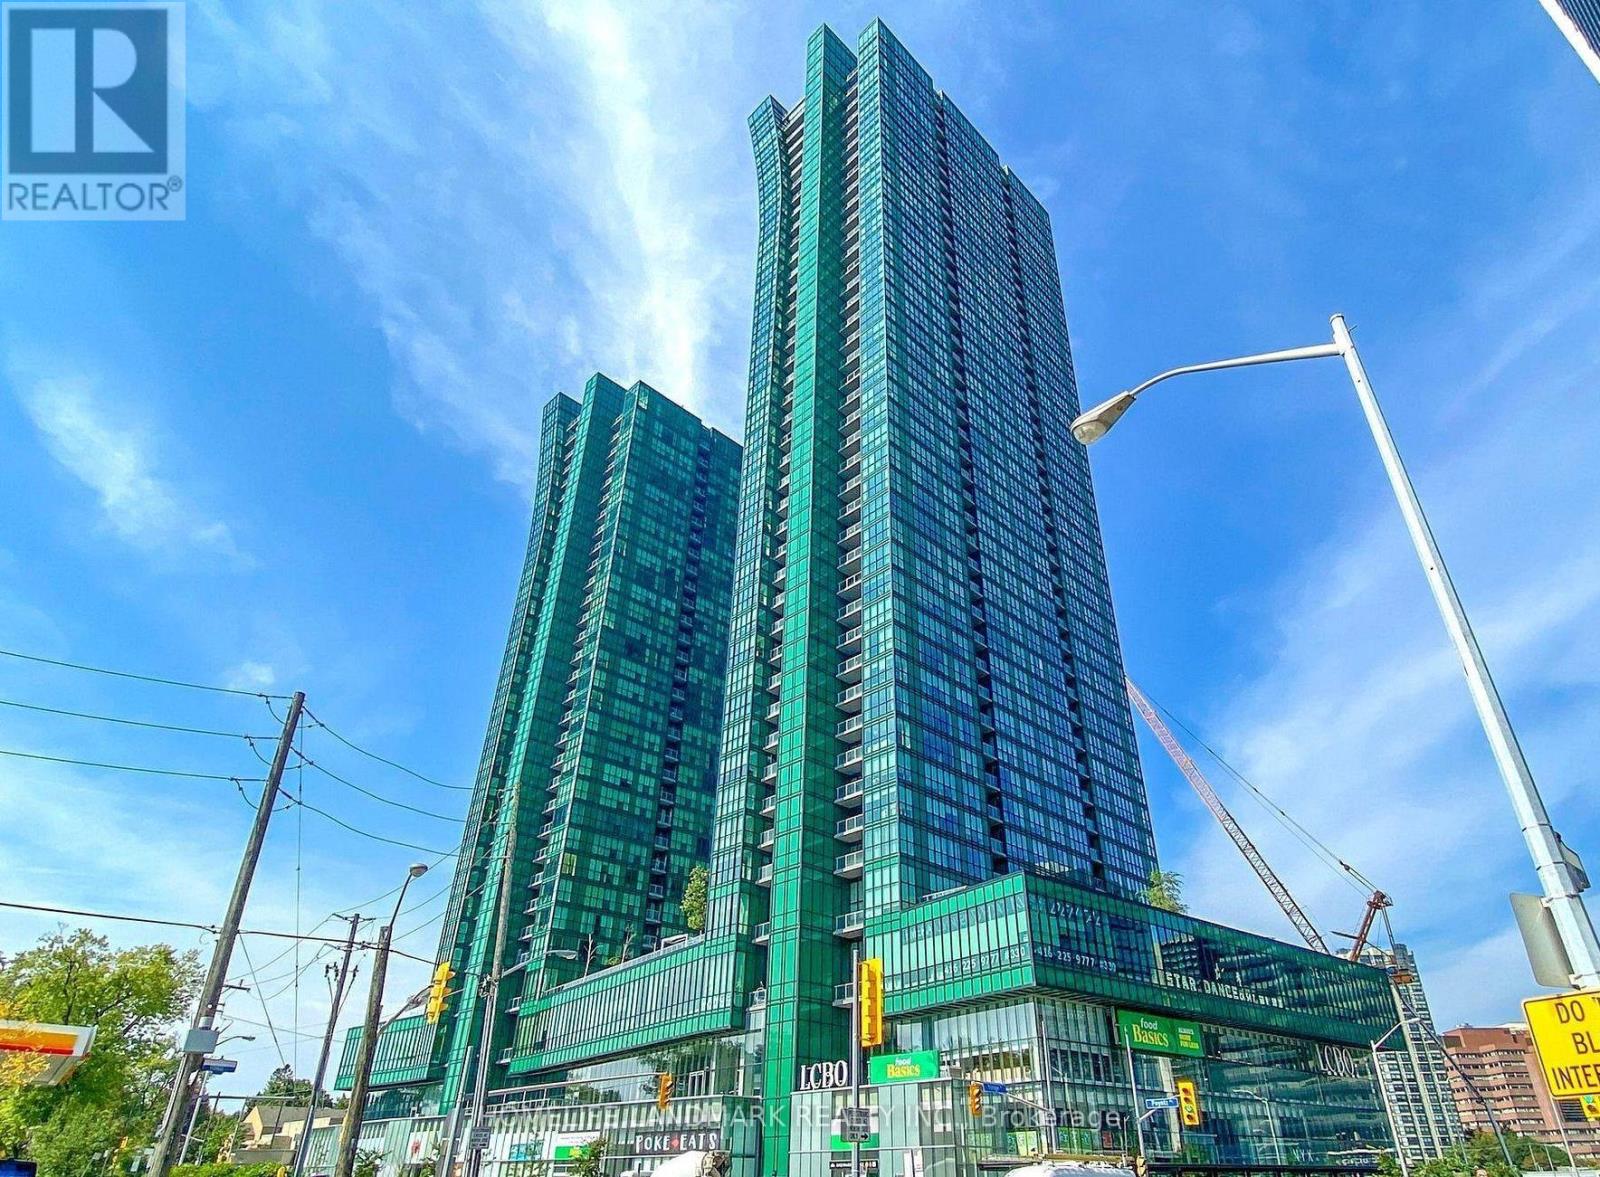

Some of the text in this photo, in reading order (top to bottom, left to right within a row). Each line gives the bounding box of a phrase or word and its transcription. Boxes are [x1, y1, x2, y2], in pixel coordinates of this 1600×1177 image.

[1165, 971, 1197, 992] STAR
[1140, 1017, 1158, 1030] food
[1555, 1000, 1585, 1024] DO
[1132, 1023, 1169, 1048] Basics
[1314, 1043, 1355, 1076] LCBO
[800, 1060, 848, 1091] LCBO
[635, 1132, 718, 1154] POKE EATS
